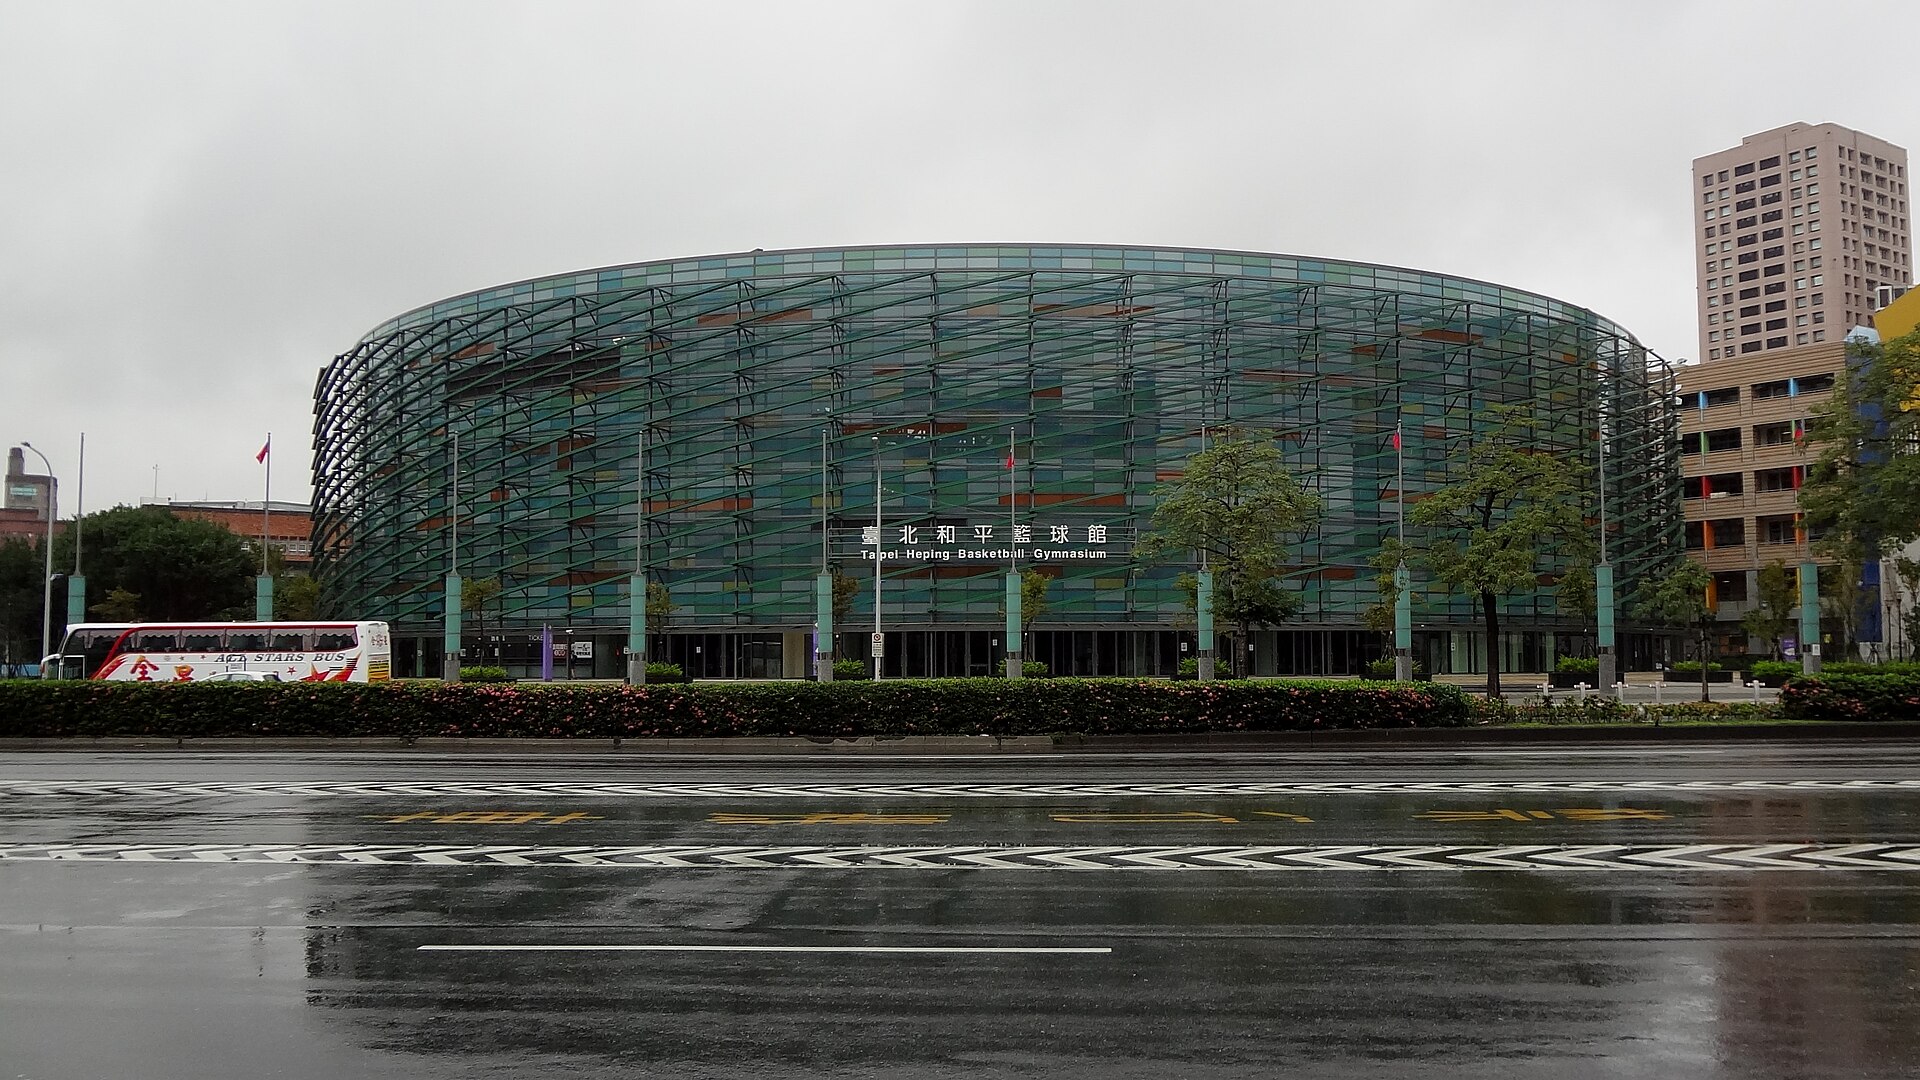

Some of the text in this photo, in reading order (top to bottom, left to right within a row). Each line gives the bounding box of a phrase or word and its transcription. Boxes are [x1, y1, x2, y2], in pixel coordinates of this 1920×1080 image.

[862, 524, 1107, 545] 臺北和平籃球館
[861, 549, 1107, 561] Tapei Heping Basketball Gymnasium
[254, 653, 305, 662] STARS
[312, 653, 346, 662] BUS
